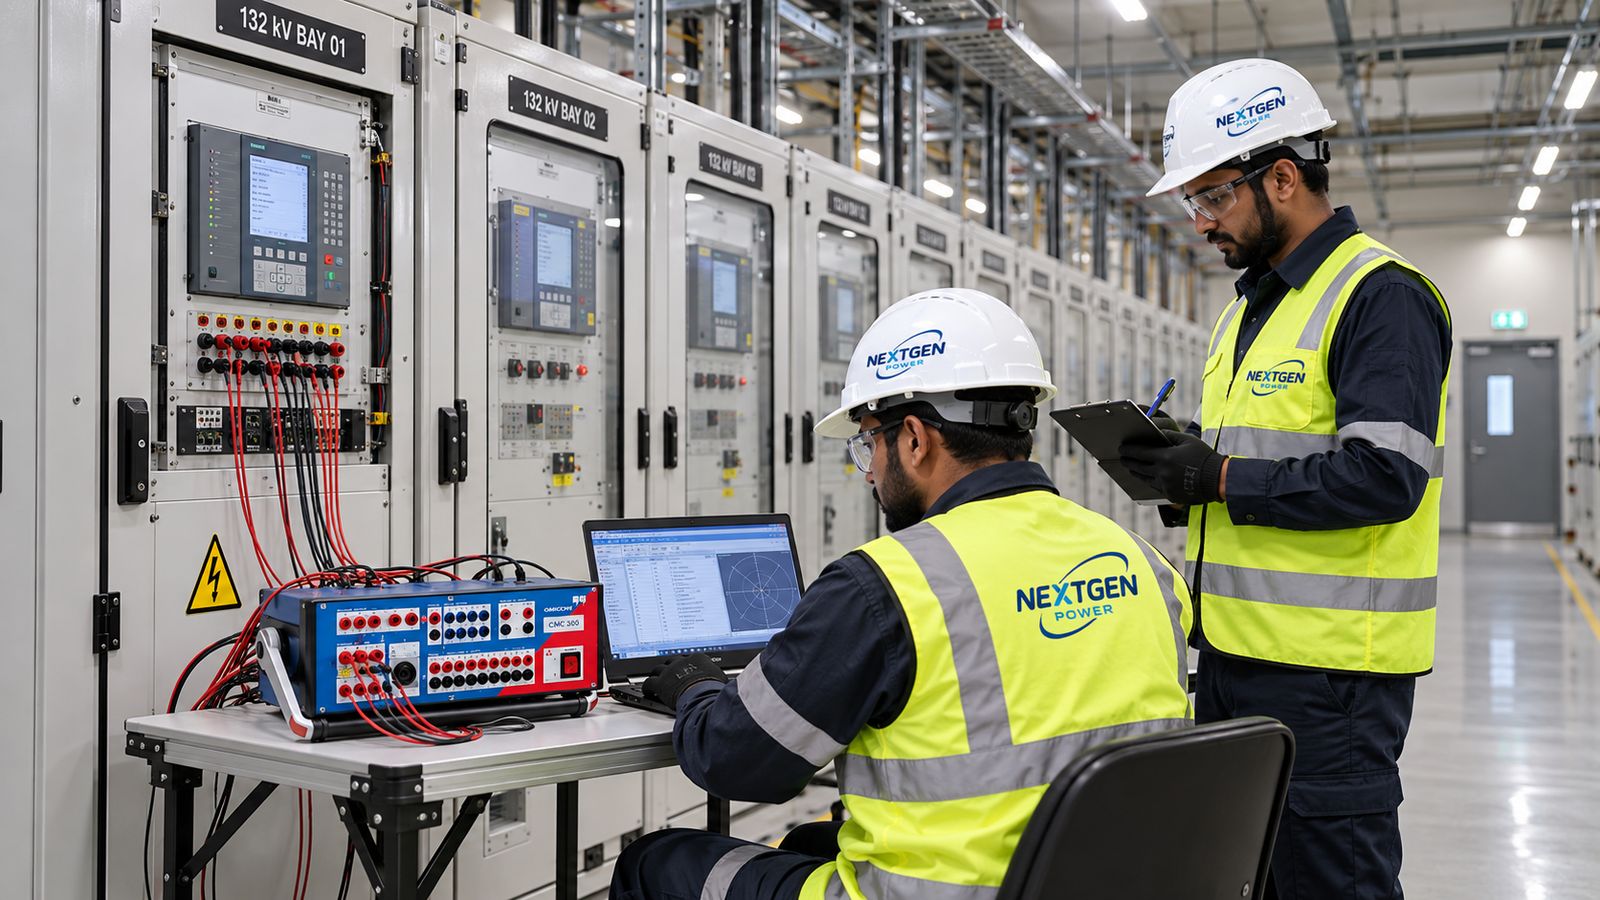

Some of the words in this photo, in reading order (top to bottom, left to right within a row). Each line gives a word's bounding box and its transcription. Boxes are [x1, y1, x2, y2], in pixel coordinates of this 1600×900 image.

[239, 6, 268, 35] 132
[272, 15, 292, 41] kV
[296, 23, 326, 52] BAY
[330, 34, 345, 58] 01
[523, 89, 542, 113] 132
[545, 96, 559, 117] kV
[561, 102, 581, 125] BAY
[583, 109, 596, 131] 02
[1216, 95, 1286, 128] NEXTGEN
[866, 341, 946, 368] NEXTGEN
[885, 359, 924, 371] POWER
[1246, 370, 1306, 384] NEXTGEN
[1016, 574, 1139, 613] NEXTGEN
[1054, 604, 1114, 621] POWER
